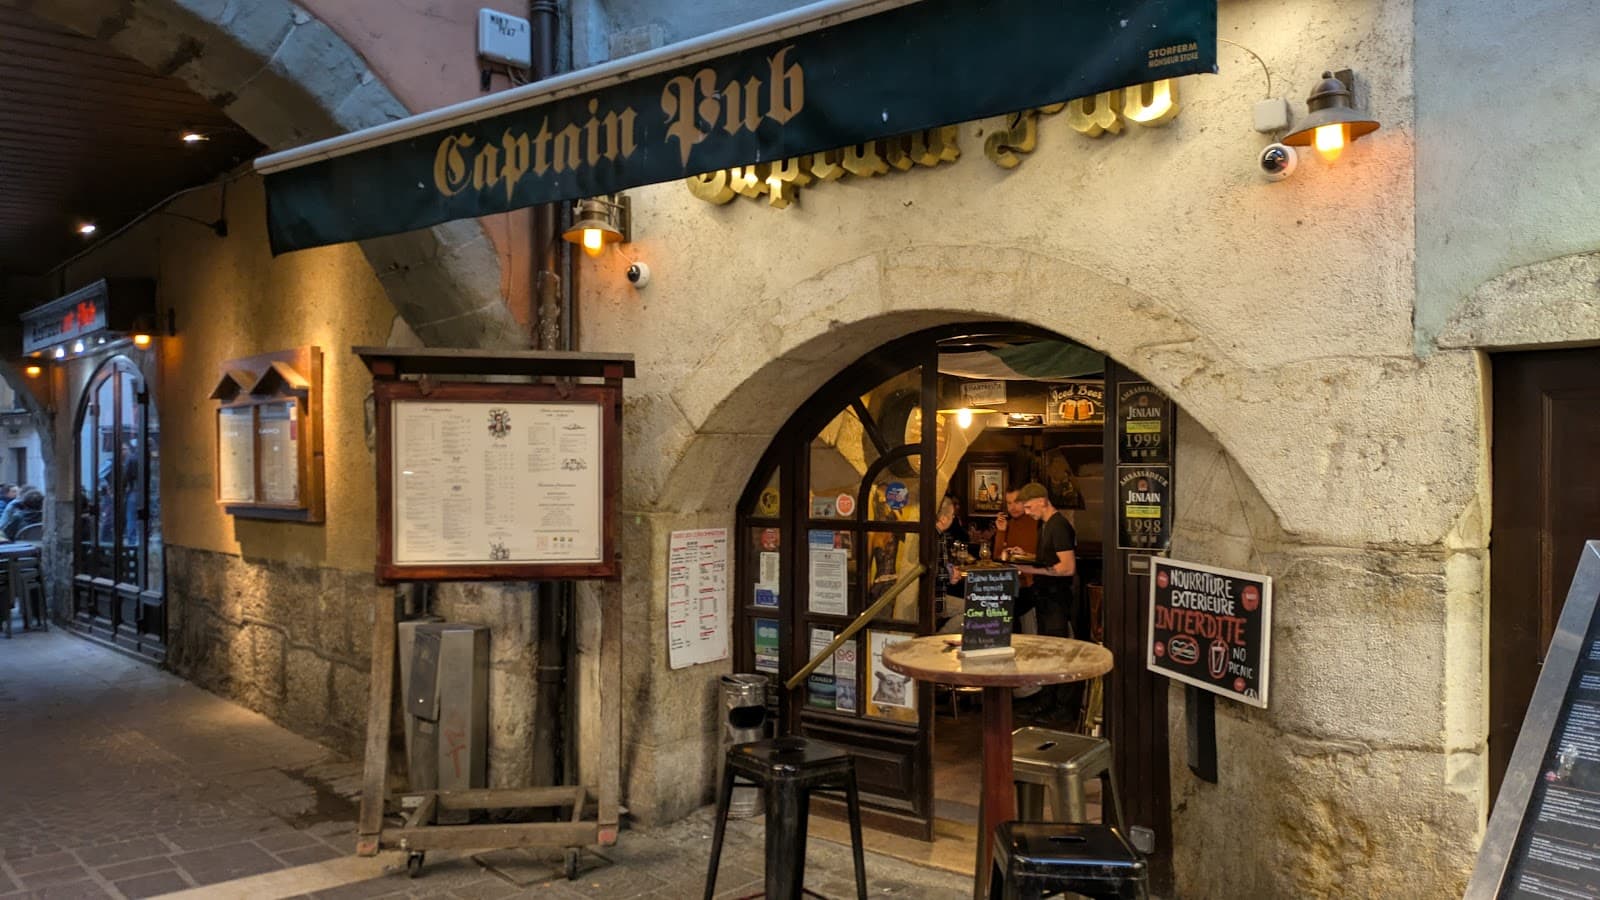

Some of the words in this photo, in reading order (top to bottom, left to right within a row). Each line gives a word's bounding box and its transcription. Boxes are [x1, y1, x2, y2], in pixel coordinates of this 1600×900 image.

[1148, 42, 1198, 58] STORFERM
[433, 98, 638, 202] Captain
[661, 44, 805, 168] Pub
[1126, 406, 1161, 420] JENLAIN
[1126, 434, 1161, 448] 1999
[1126, 490, 1161, 504] JENLAIN
[1127, 519, 1161, 533] 1998
[1170, 569, 1235, 599] NOURRITURE
[1155, 604, 1248, 646] INTERDITE
[1232, 647, 1246, 663] NO
[1228, 661, 1254, 680] PICNIC
